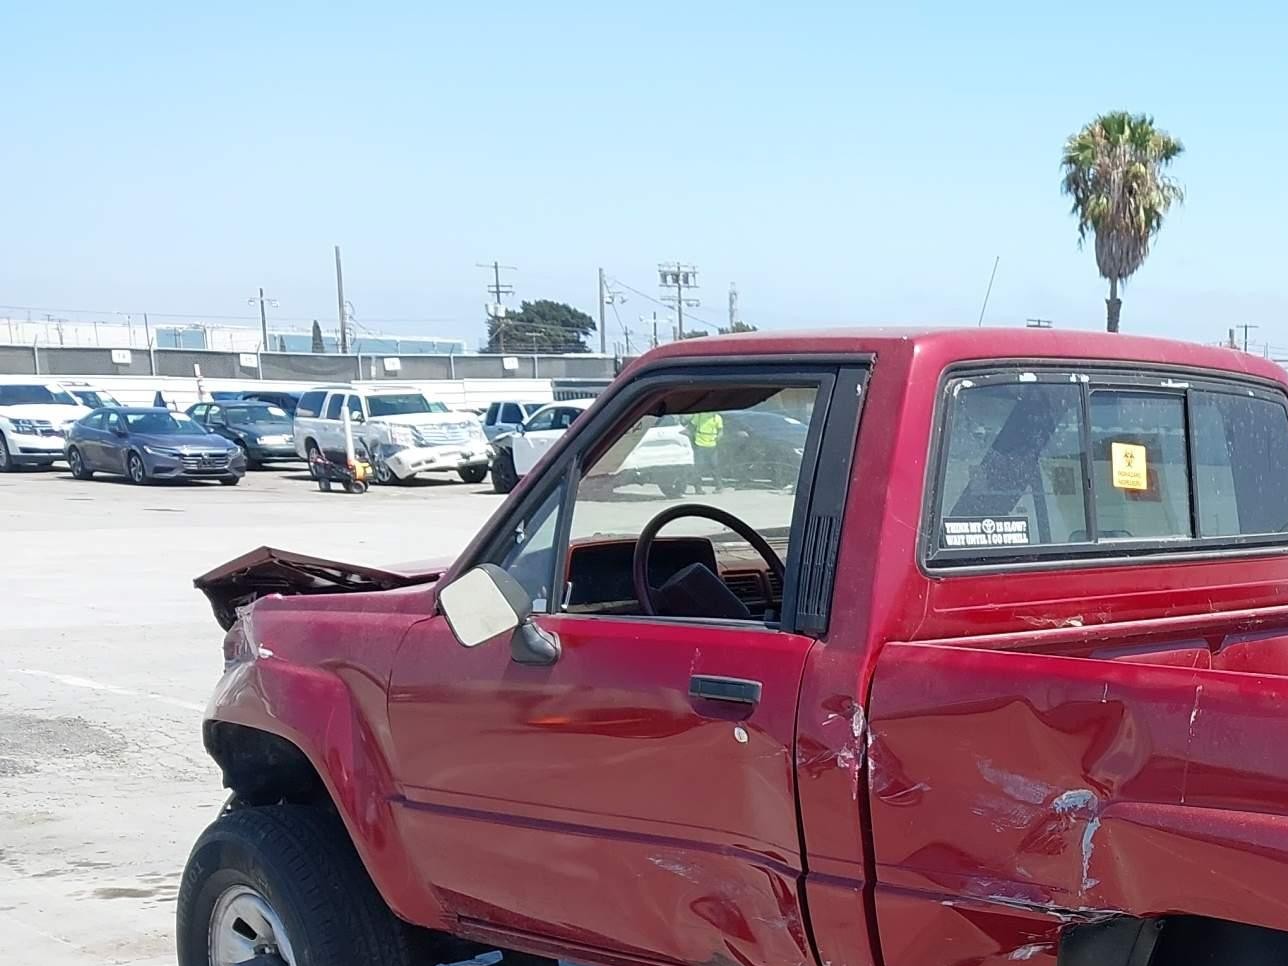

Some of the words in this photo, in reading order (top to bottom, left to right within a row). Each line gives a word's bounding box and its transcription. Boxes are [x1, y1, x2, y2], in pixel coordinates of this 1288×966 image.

[945, 522, 969, 533] THINK
[969, 522, 981, 533] MY
[995, 521, 1003, 532] IS
[1004, 521, 1026, 532] SLOW?
[946, 534, 965, 545] WAIT
[966, 534, 987, 545] UNTIL
[987, 534, 992, 545] I
[992, 533, 1003, 544] GO
[1003, 533, 1028, 544] UPHILL
